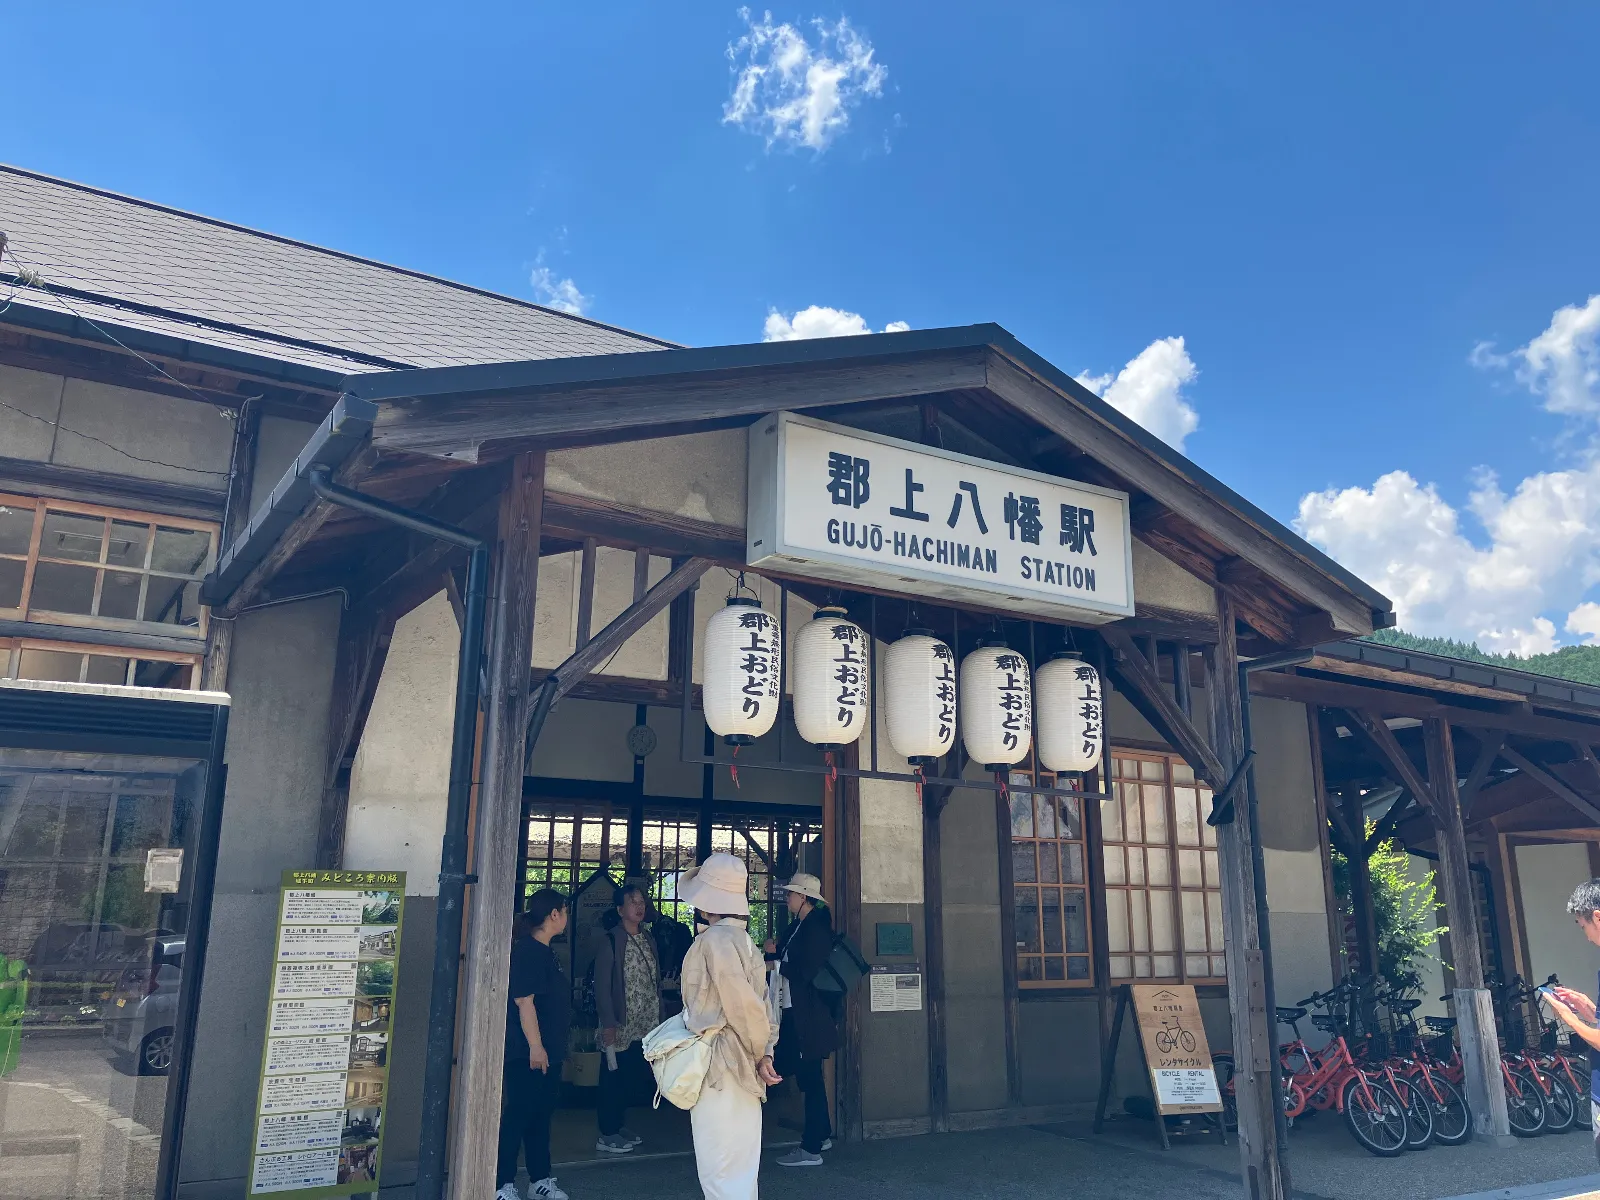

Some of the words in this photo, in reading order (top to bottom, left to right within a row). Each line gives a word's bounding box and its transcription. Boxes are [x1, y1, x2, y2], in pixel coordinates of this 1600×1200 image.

[826, 451, 1097, 557] 郡上八幡駅
[827, 518, 998, 574] GUJŌ-HACHIMAN
[1020, 556, 1097, 592] STATION
[737, 612, 771, 720] 郡上おどり
[830, 624, 860, 728] 郡上おどり
[931, 643, 955, 744] 郡上おどり
[994, 654, 1024, 751] 郡上おどり
[1073, 666, 1100, 759] 郡上おどり
[1159, 1058, 1202, 1067] レンタサイクル
